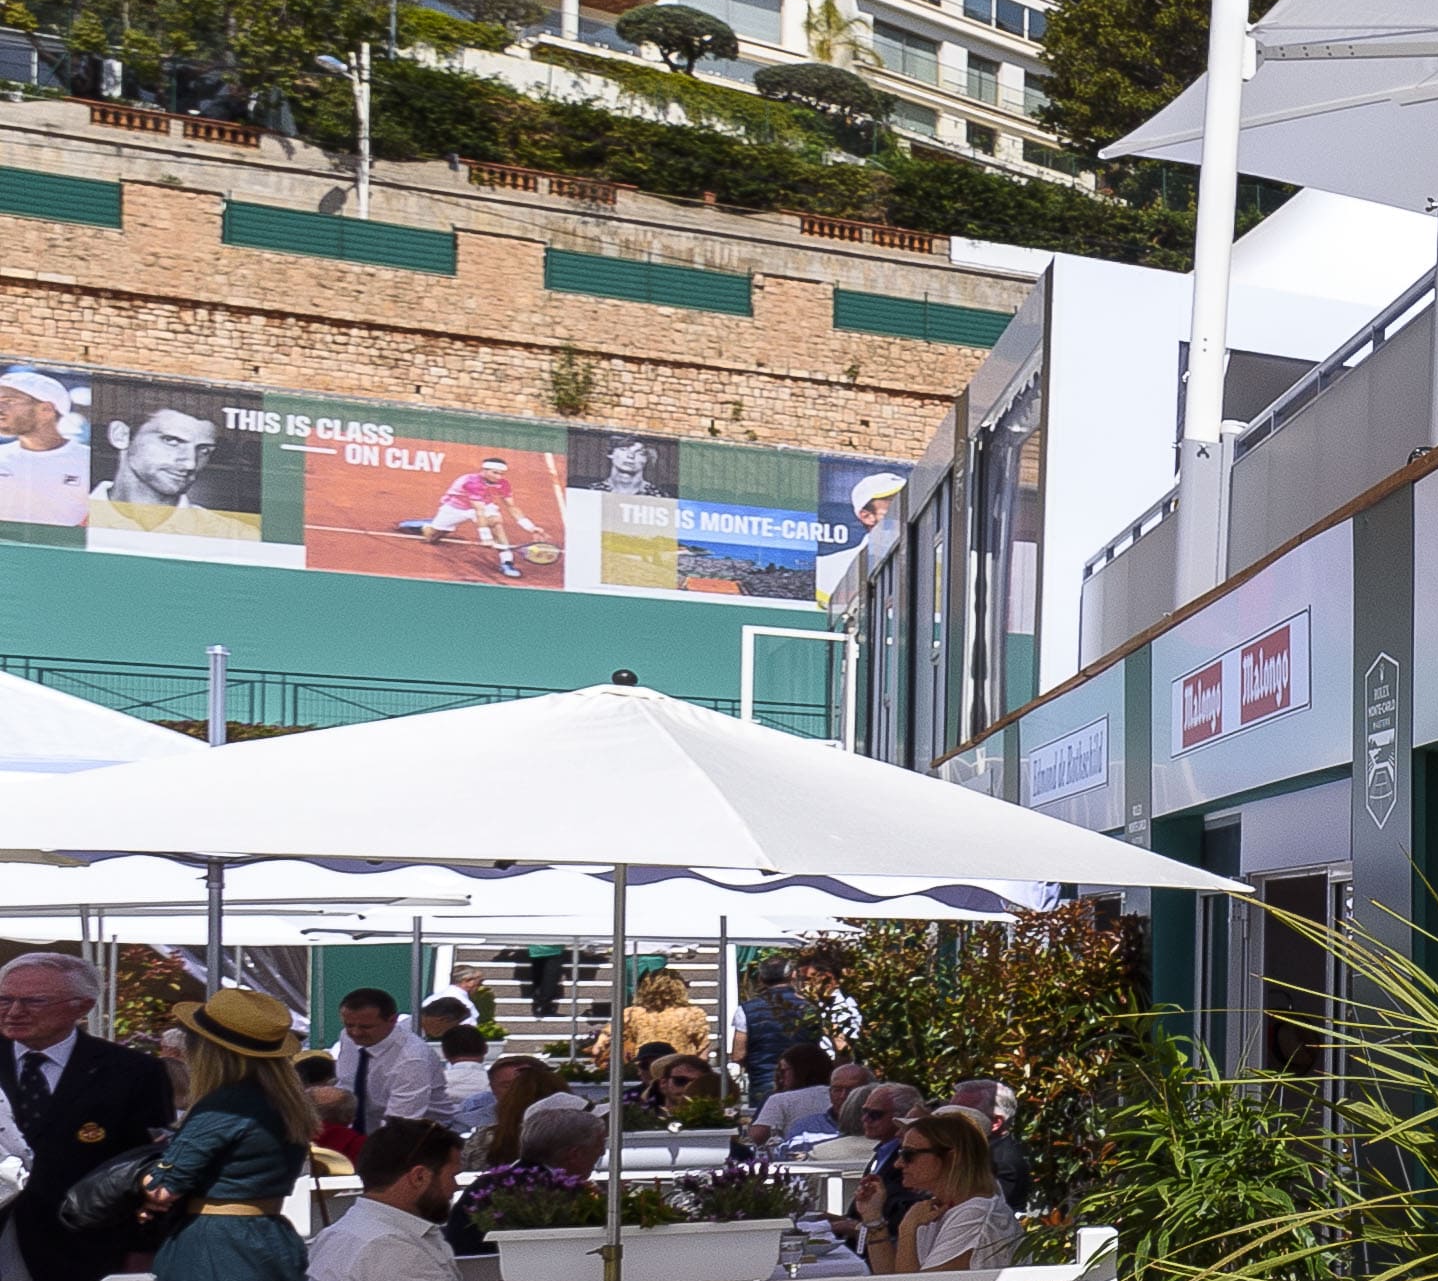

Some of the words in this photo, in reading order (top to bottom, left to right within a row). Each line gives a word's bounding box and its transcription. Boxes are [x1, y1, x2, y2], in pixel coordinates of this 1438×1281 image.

[222, 407, 281, 434] THIS
[286, 415, 311, 437] IS
[316, 418, 394, 446] CLASS
[345, 444, 379, 466] ON
[385, 448, 445, 473] CLAY
[619, 503, 669, 527] THIS
[675, 511, 695, 530] IS
[701, 512, 848, 544] MONTE-CARLO
[1242, 647, 1289, 707] Malongo
